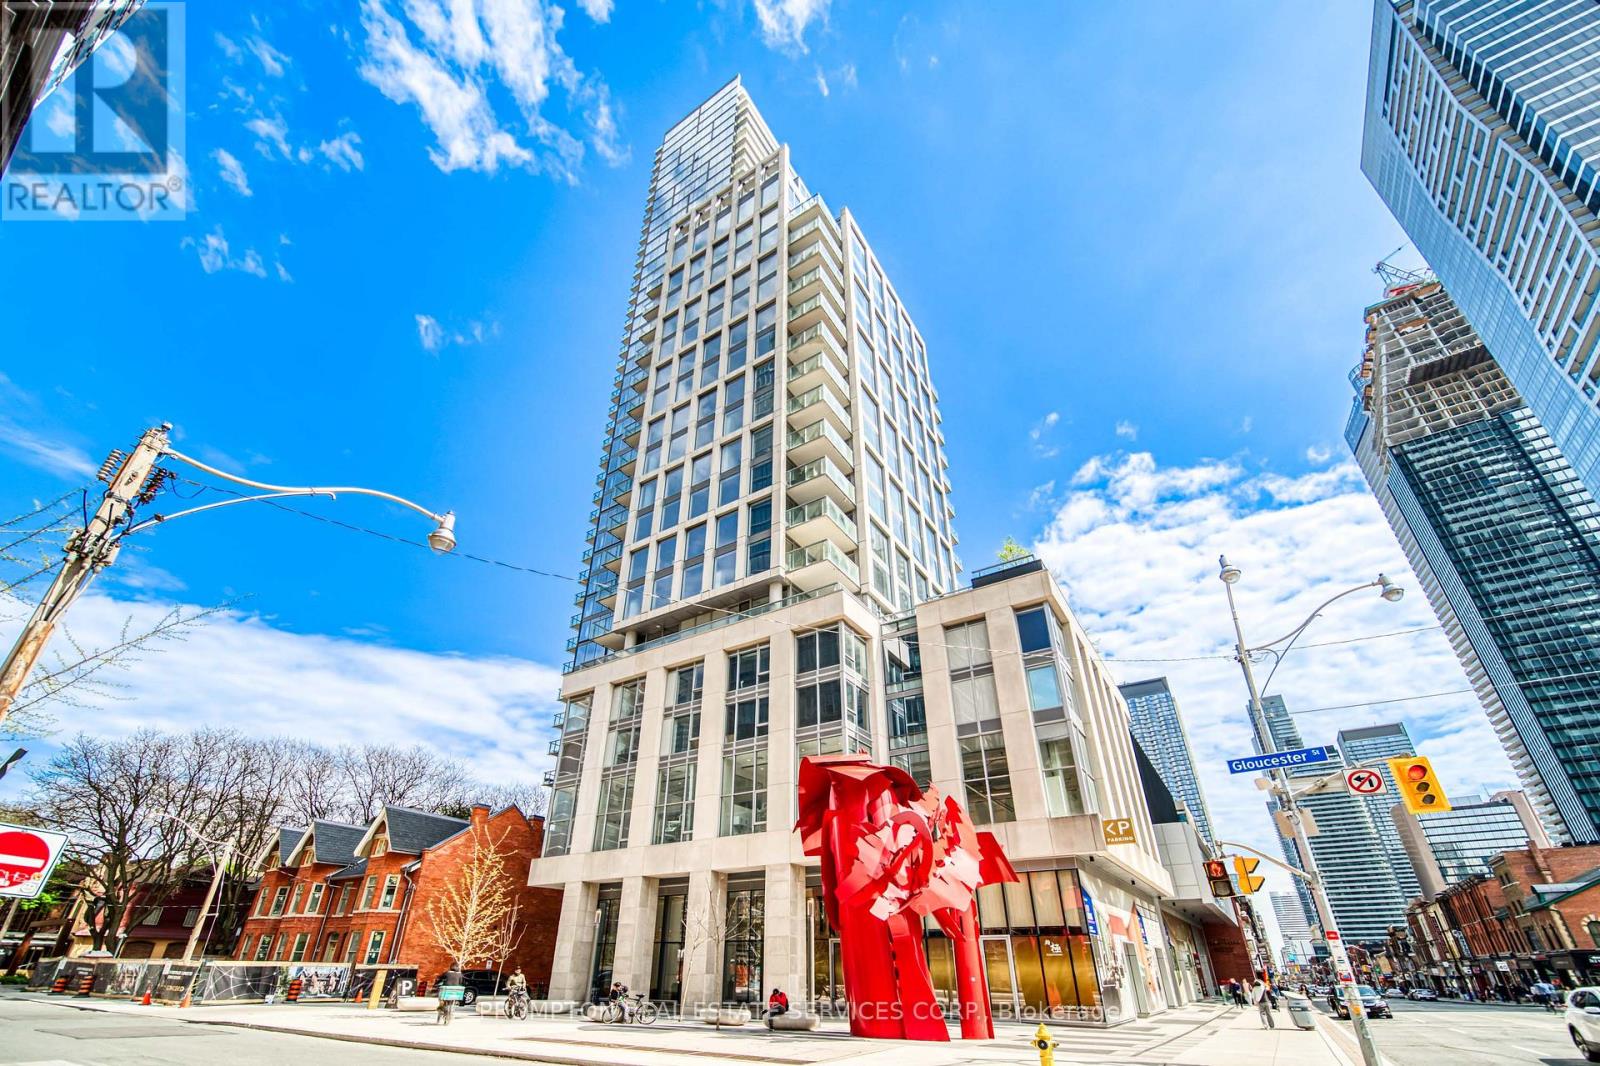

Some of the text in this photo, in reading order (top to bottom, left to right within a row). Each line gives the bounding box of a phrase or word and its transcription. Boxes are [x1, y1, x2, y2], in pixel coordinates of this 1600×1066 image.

[1232, 753, 1307, 771] Gloucester
[1118, 821, 1130, 835] P
[401, 980, 413, 995] P
